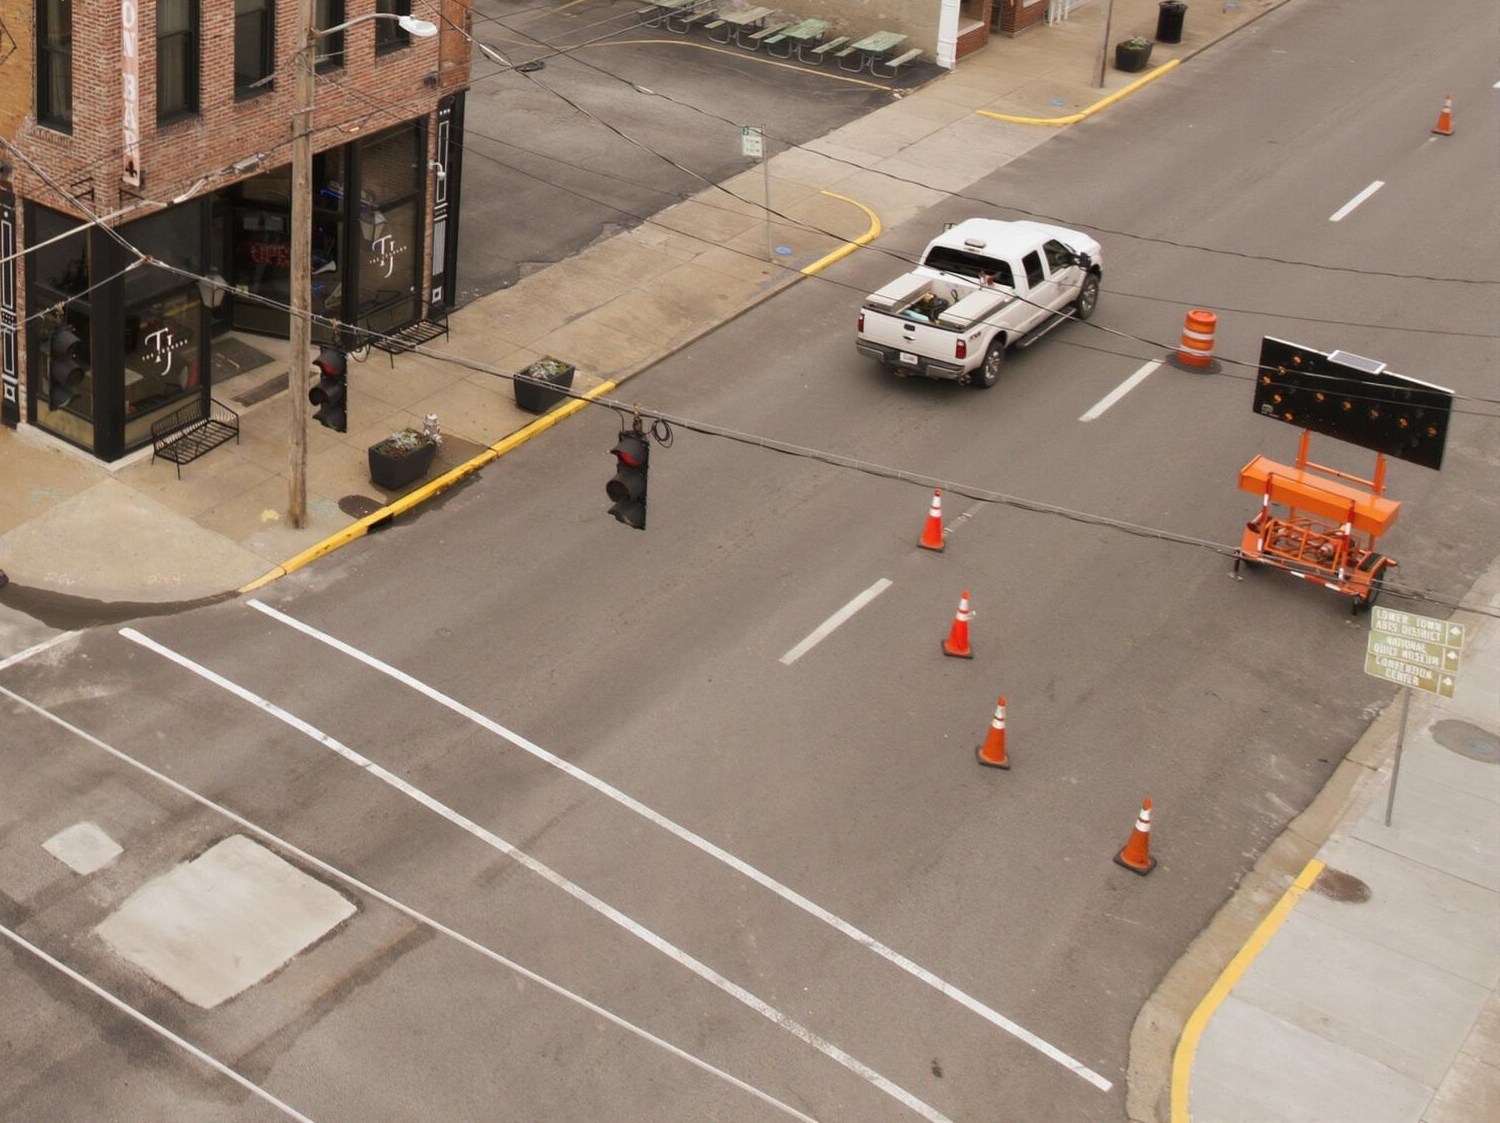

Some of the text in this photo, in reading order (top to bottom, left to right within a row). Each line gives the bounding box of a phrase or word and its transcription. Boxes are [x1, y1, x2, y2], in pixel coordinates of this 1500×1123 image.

[251, 243, 291, 266] OPE
[1375, 620, 1441, 642] ARTS DISTRICT
[1376, 609, 1442, 632] LOWER TOWN
[1373, 642, 1440, 666] QUILT MUSEUM
[1386, 636, 1427, 654] NATIONAL
[1375, 656, 1433, 680] CONVENTION
[1385, 668, 1419, 687] CENTER
